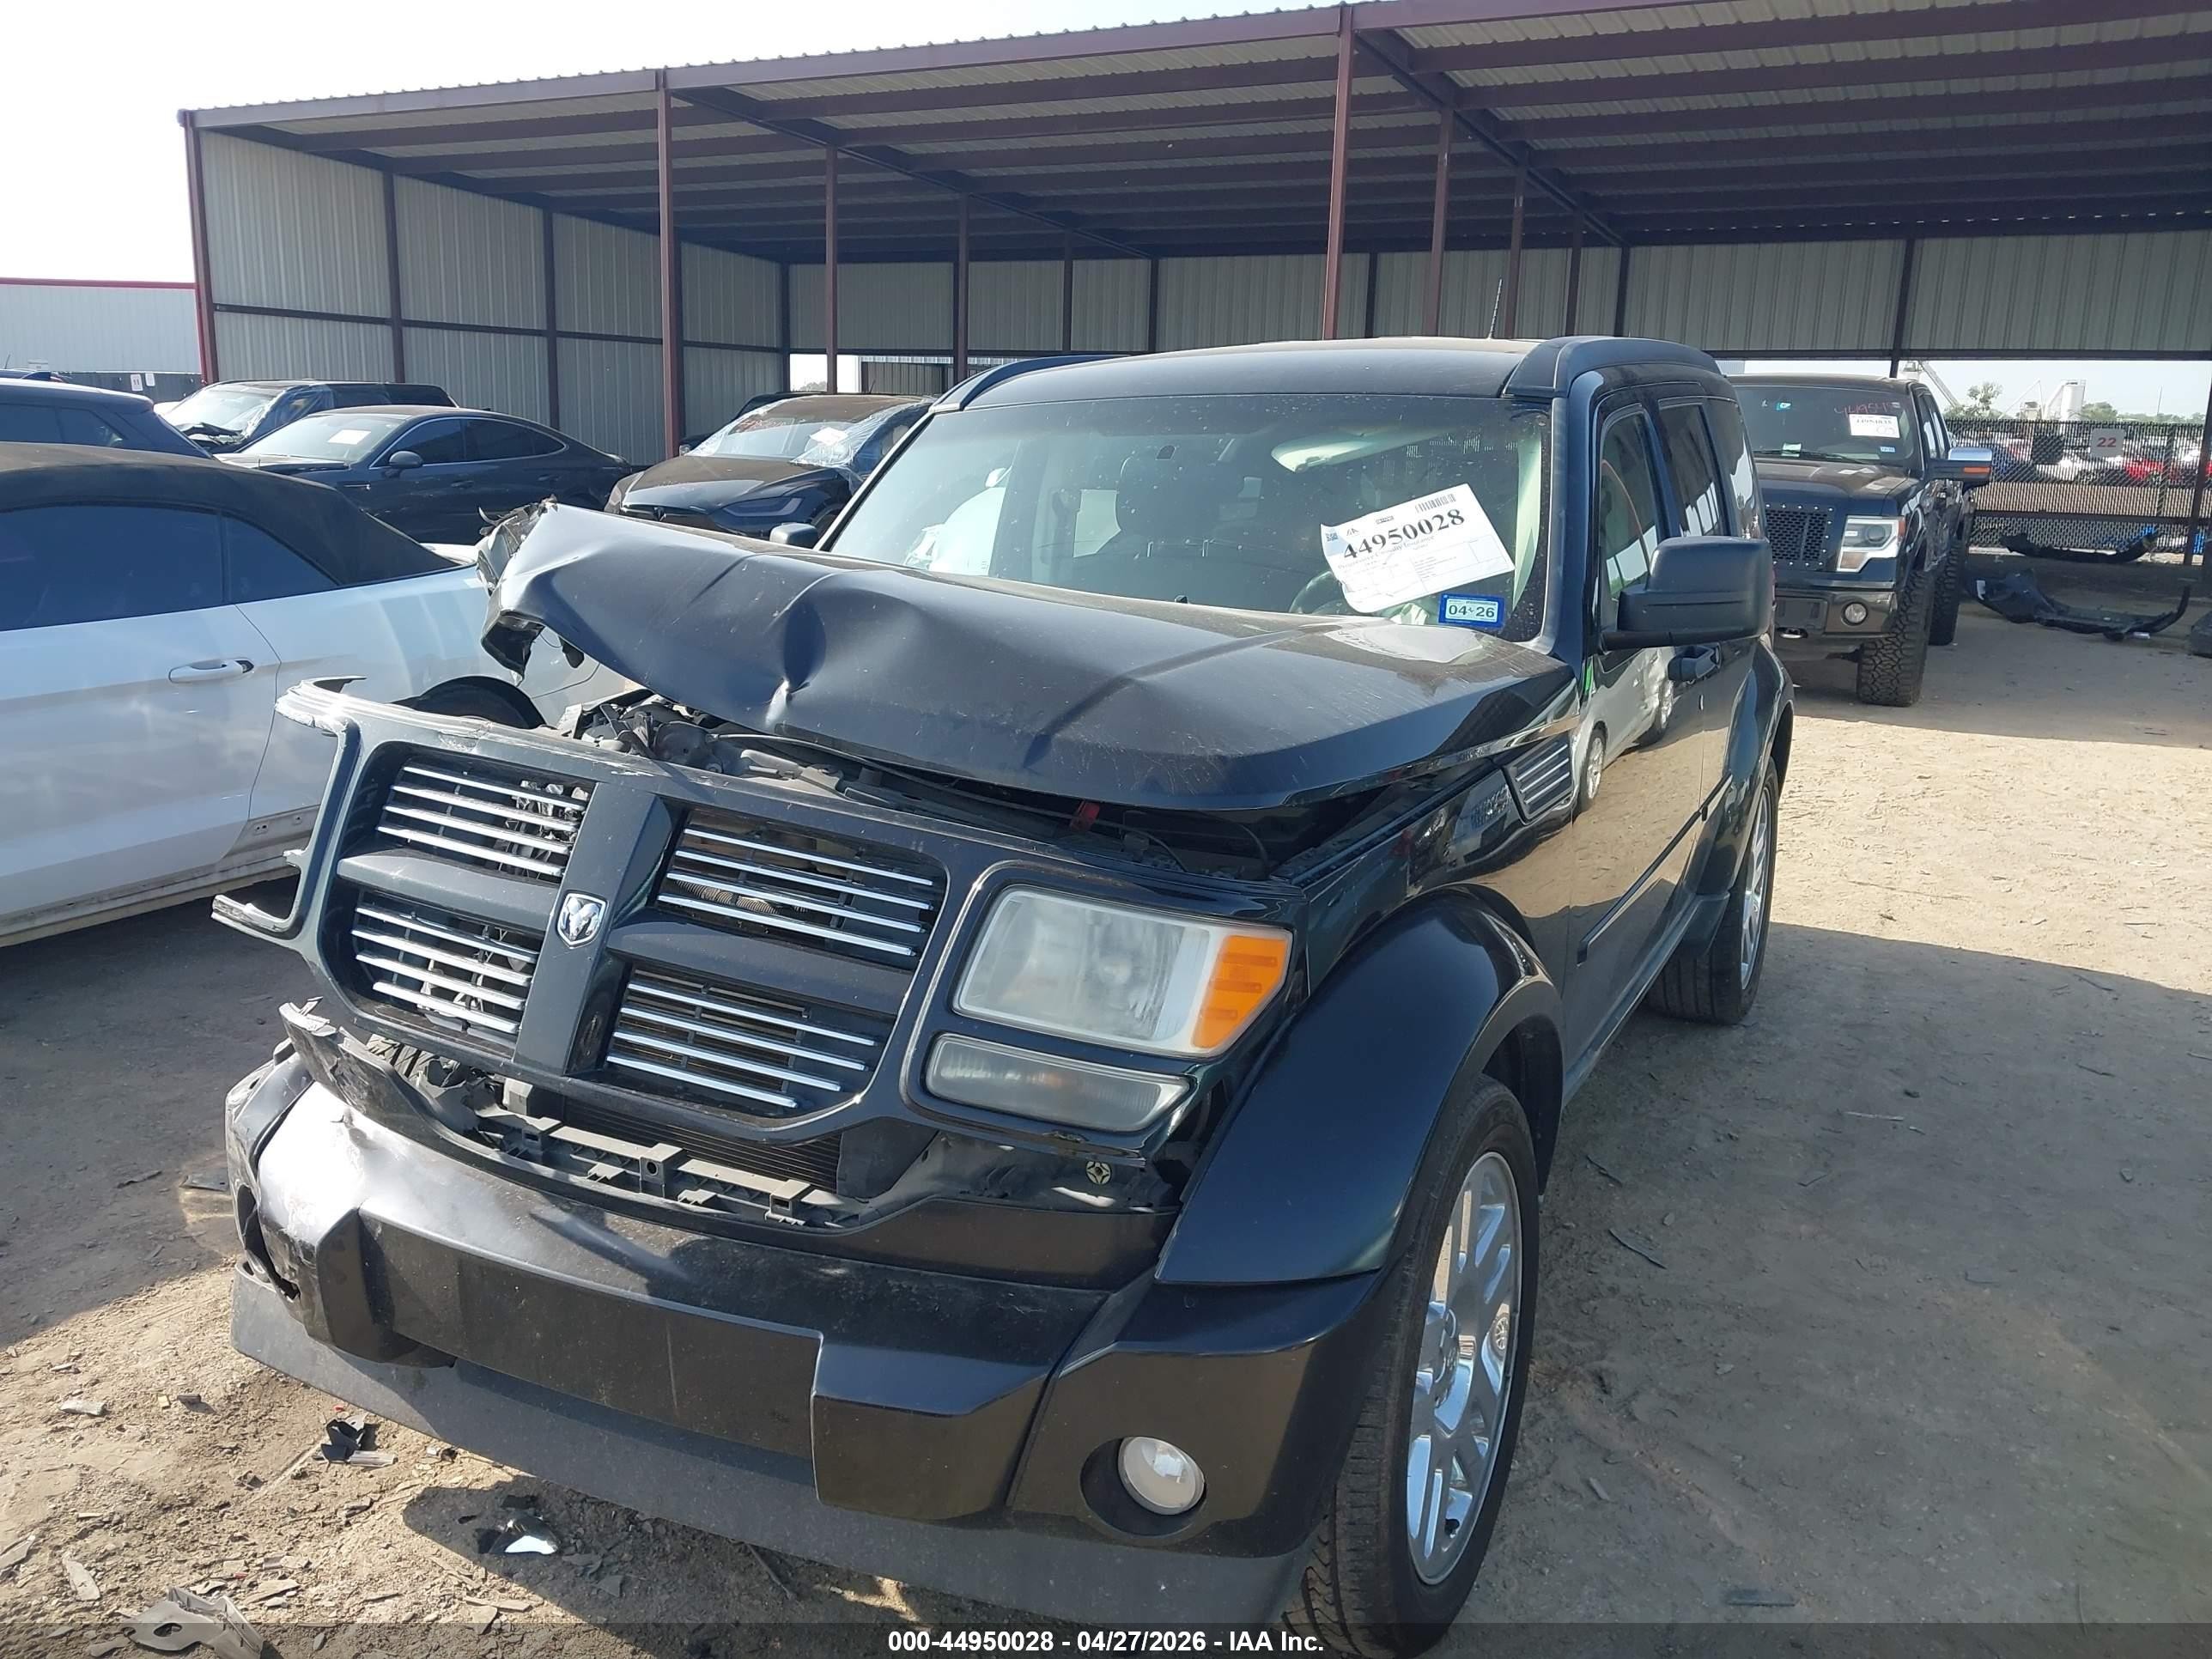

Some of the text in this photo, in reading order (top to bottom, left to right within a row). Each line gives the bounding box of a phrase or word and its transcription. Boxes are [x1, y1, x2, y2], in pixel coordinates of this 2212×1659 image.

[2097, 436, 2117, 447] 22
[1343, 508, 1465, 558] 44950028
[1449, 605, 1495, 617] 04 26
